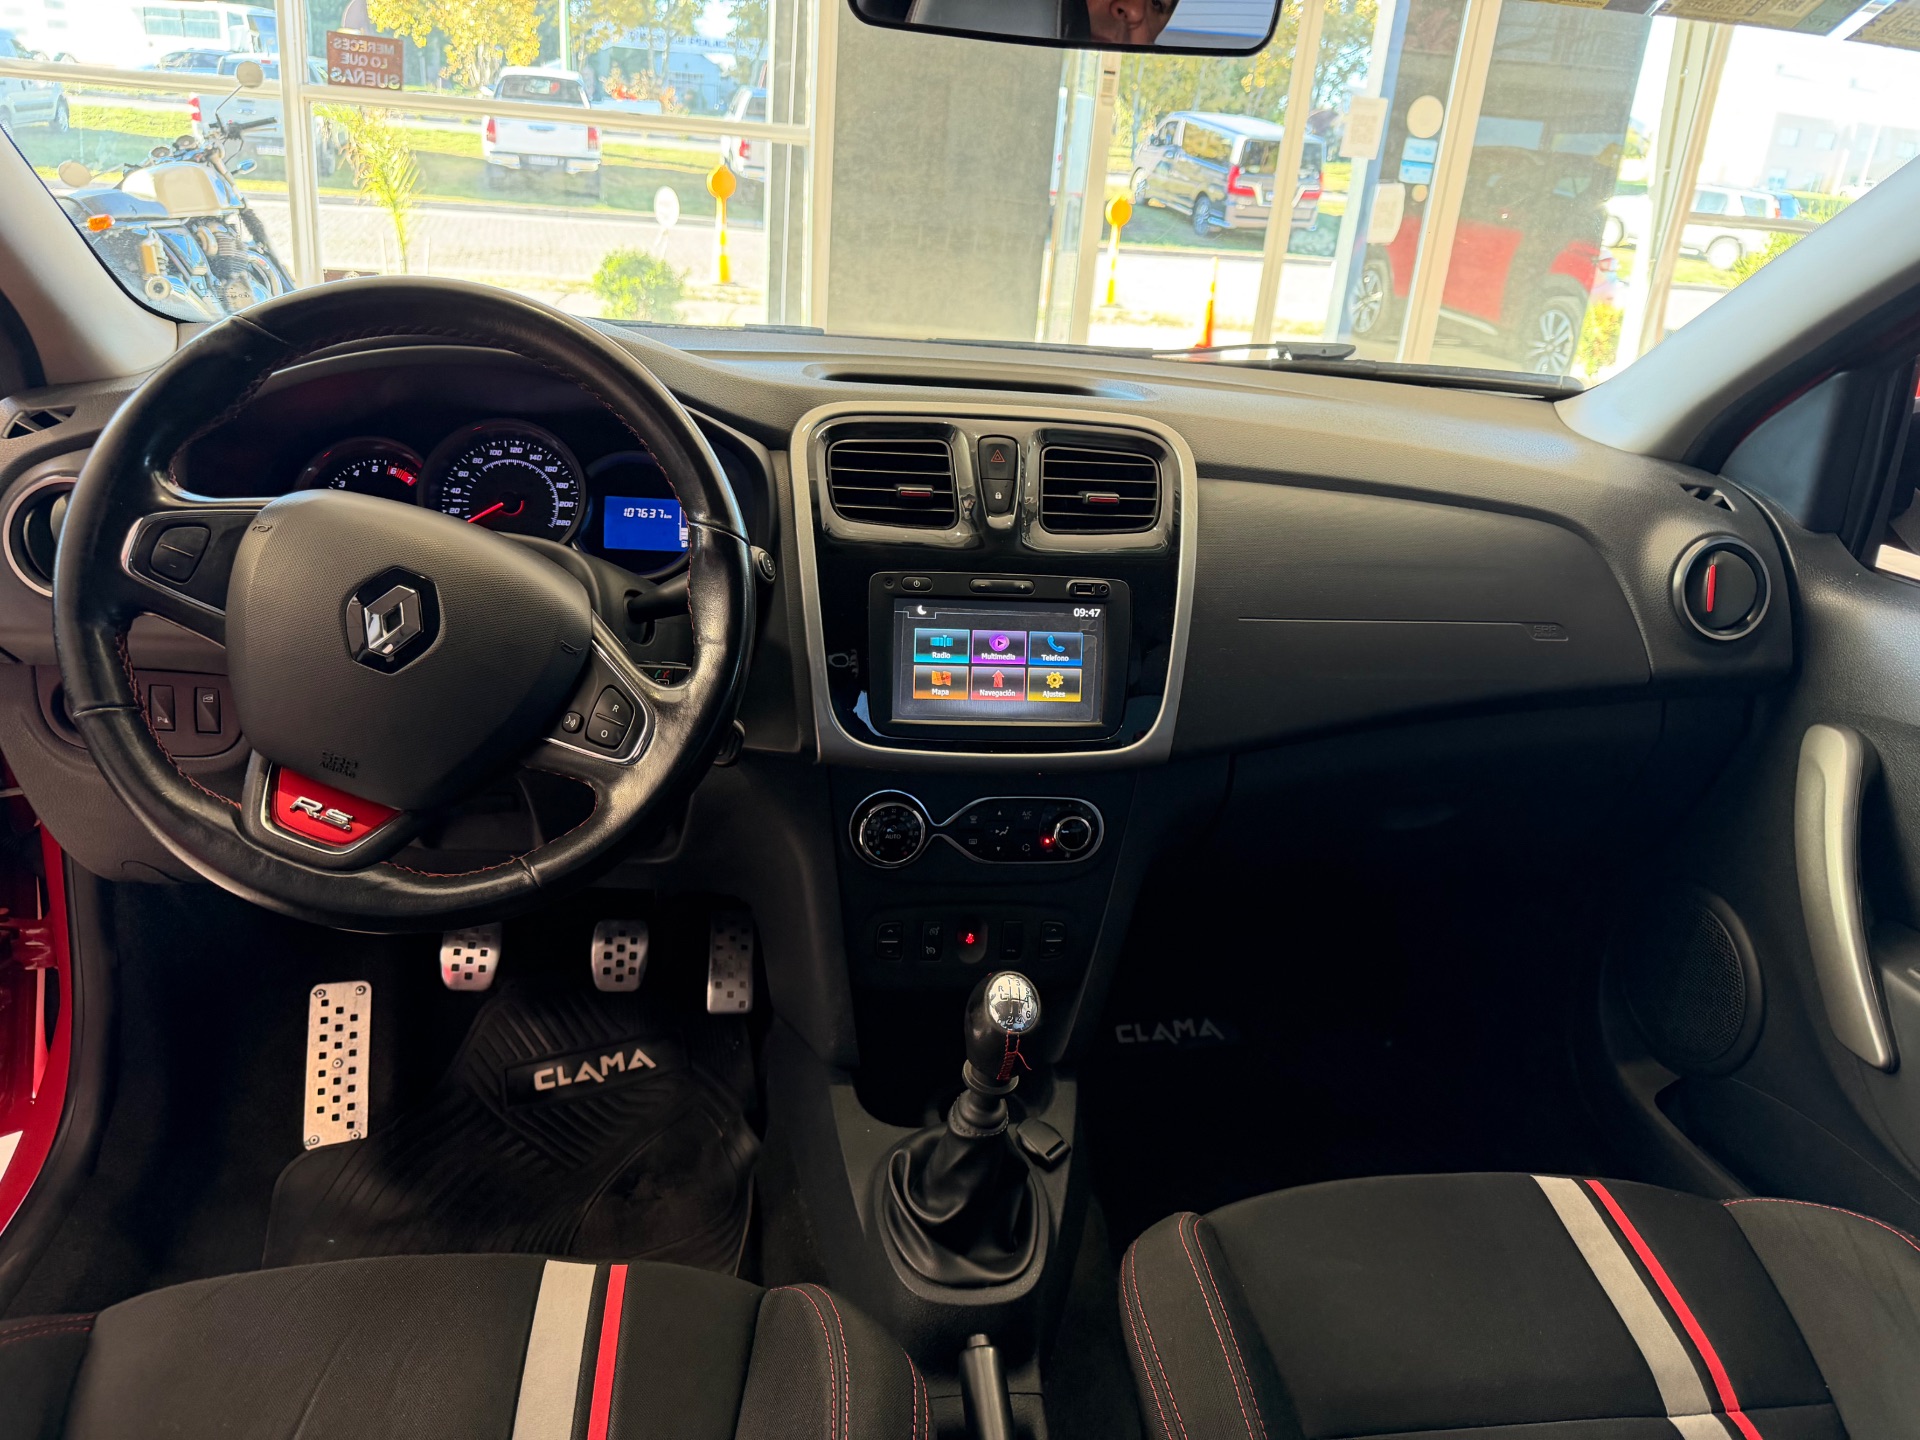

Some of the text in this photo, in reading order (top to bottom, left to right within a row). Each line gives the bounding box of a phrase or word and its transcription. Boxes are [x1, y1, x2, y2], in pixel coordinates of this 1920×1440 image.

[489, 449, 503, 457] 100
[352, 469, 360, 477] 4
[371, 465, 379, 473] 5
[389, 467, 397, 475] 6
[544, 465, 558, 473] 160
[338, 480, 346, 488] 3
[406, 476, 414, 484] 7
[559, 500, 574, 508] 200
[556, 519, 571, 527] 220
[1073, 607, 1101, 618] 09:47
[932, 651, 951, 660] Radio
[981, 652, 1016, 661] Multimedia
[1041, 654, 1070, 662] Telefono
[931, 688, 950, 697] Mapa
[979, 689, 1016, 698] Navegación
[1042, 690, 1066, 698] Ajustes
[611, 704, 620, 713] R
[1025, 1010, 1031, 1019] 6
[1114, 1017, 1226, 1045] CLAMA
[533, 1048, 657, 1092] CLAMA
